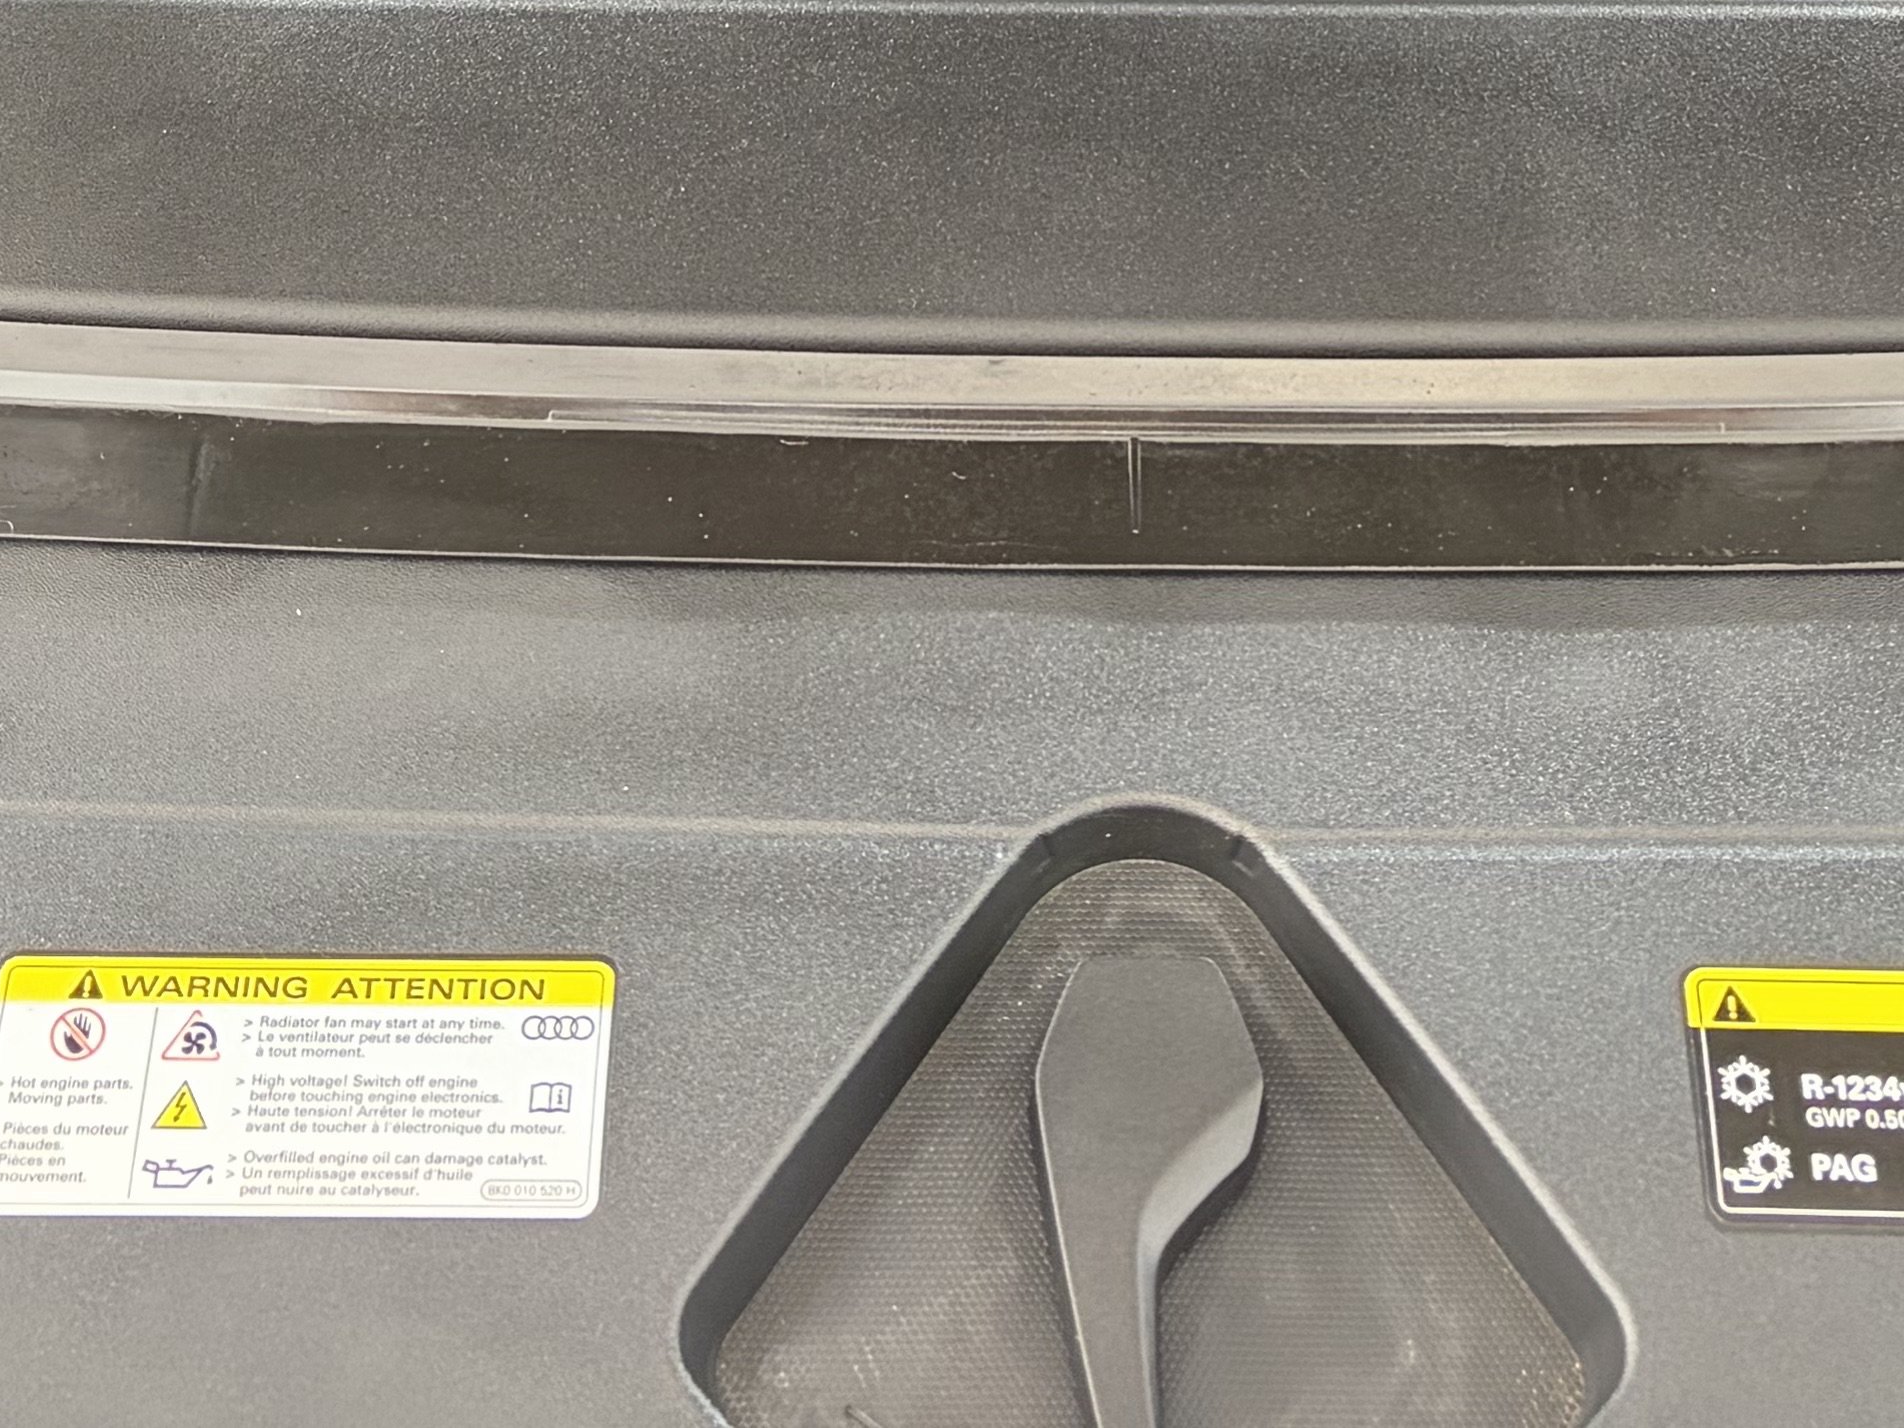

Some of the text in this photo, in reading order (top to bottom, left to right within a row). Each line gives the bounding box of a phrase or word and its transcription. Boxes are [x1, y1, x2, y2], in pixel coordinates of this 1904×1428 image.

[121, 975, 545, 1000] WARNING ATTENTION
[259, 1015, 505, 1031] Radiator fan may start at any time.
[258, 1030, 493, 1045] Le ventilateur peut se déclencher
[268, 1047, 296, 1058] tout
[301, 1048, 365, 1058] moment.
[10, 1076, 133, 1093] Hot engine parts.
[251, 1074, 478, 1090] High voltage! Switch off engine
[8, 1092, 108, 1108] Moving parts.
[249, 1090, 503, 1105] before touching engine electronics.
[247, 1105, 482, 1119] Haute tension! Arrêter le moteur
[1805, 1107, 1861, 1128] GWP
[2, 1122, 129, 1136] Pièces du moteur
[245, 1121, 285, 1133] avant
[290, 1121, 307, 1133] de
[312, 1121, 367, 1133] toucher
[487, 1122, 505, 1134] du
[510, 1124, 566, 1134] moteur.
[0, 1138, 64, 1151] chaudes.
[48, 1156, 66, 1167] en
[243, 1150, 548, 1168] Overfilled engine oil can damage catalyst.
[242, 1167, 263, 1179] Un
[267, 1167, 356, 1183] remplissage
[360, 1168, 419, 1180] excessif
[1811, 1153, 1878, 1183] PAG
[239, 1183, 420, 1198] peut nuire au catalyseur.
[514, 1185, 536, 1196] 010
